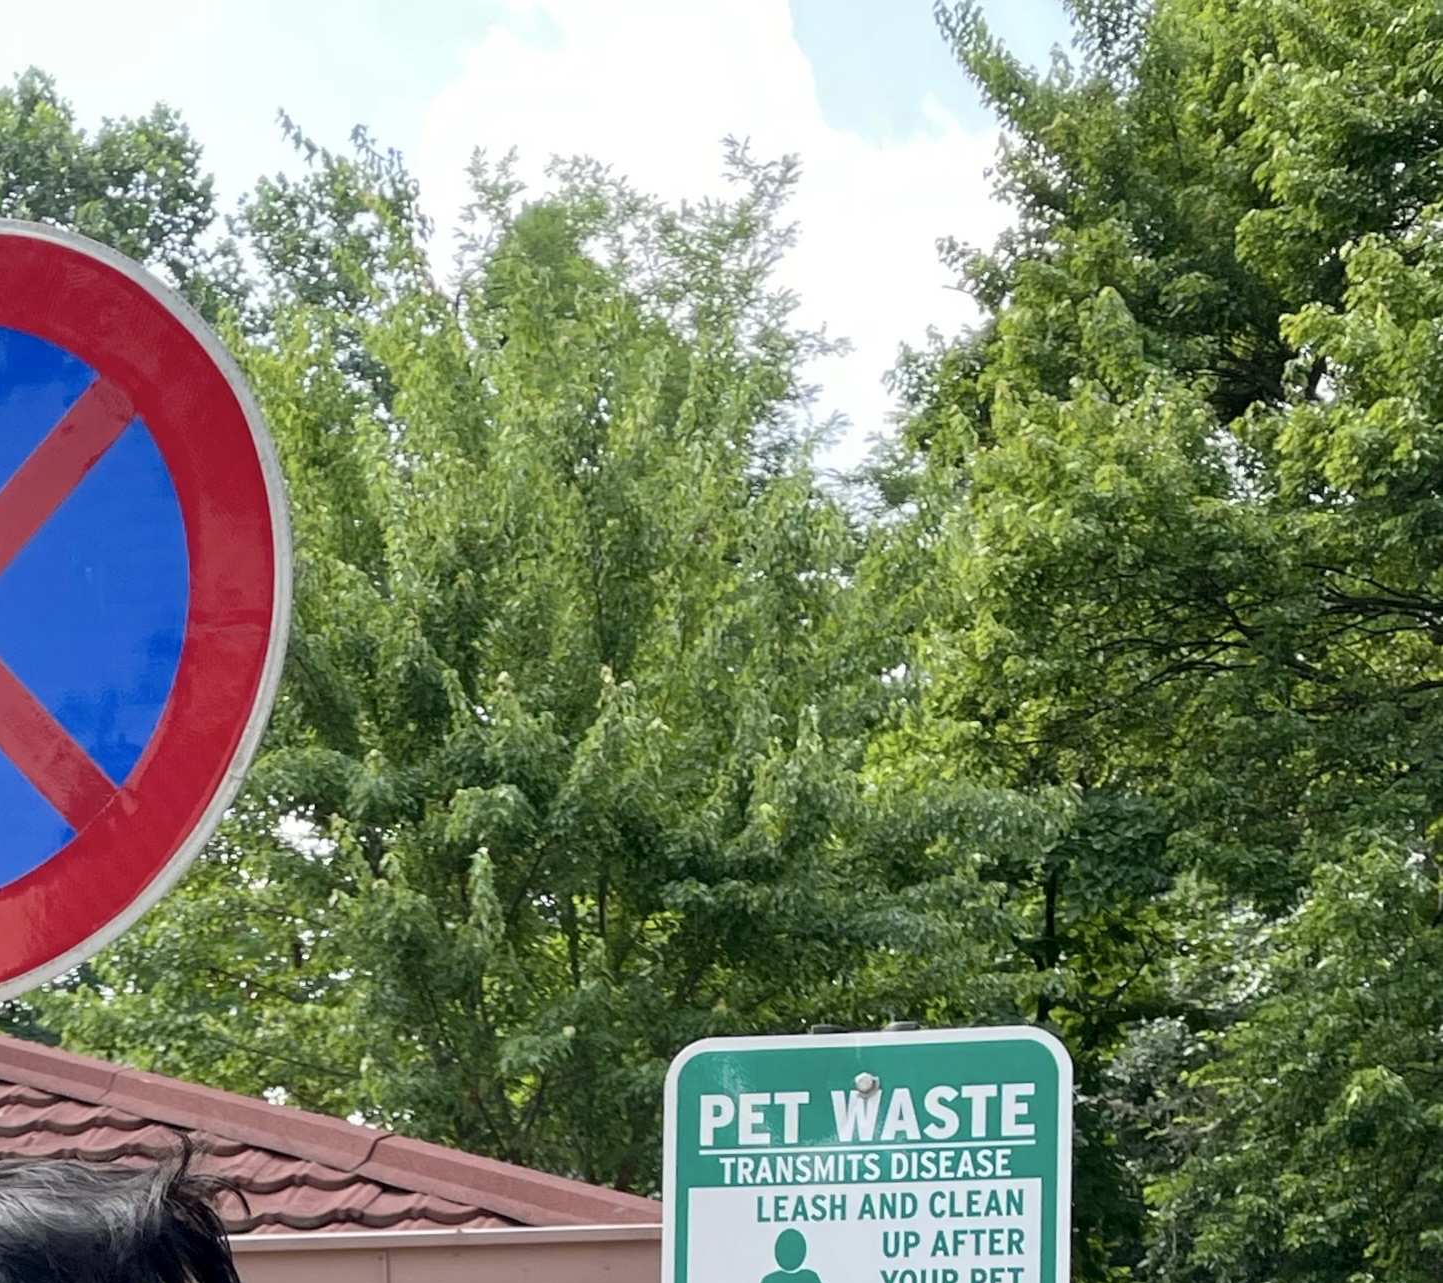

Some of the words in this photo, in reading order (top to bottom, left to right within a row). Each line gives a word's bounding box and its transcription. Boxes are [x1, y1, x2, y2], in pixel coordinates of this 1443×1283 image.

[699, 1090, 810, 1147] PET
[830, 1082, 1036, 1143] WASTE
[719, 1153, 882, 1185] TRANSMITS
[890, 1148, 1012, 1180] DISEASE
[756, 1193, 847, 1223] LEASH
[857, 1192, 919, 1221] AND
[928, 1188, 1025, 1219] CLEAN
[882, 1230, 921, 1258] UP
[930, 1228, 1025, 1257] AFTER
